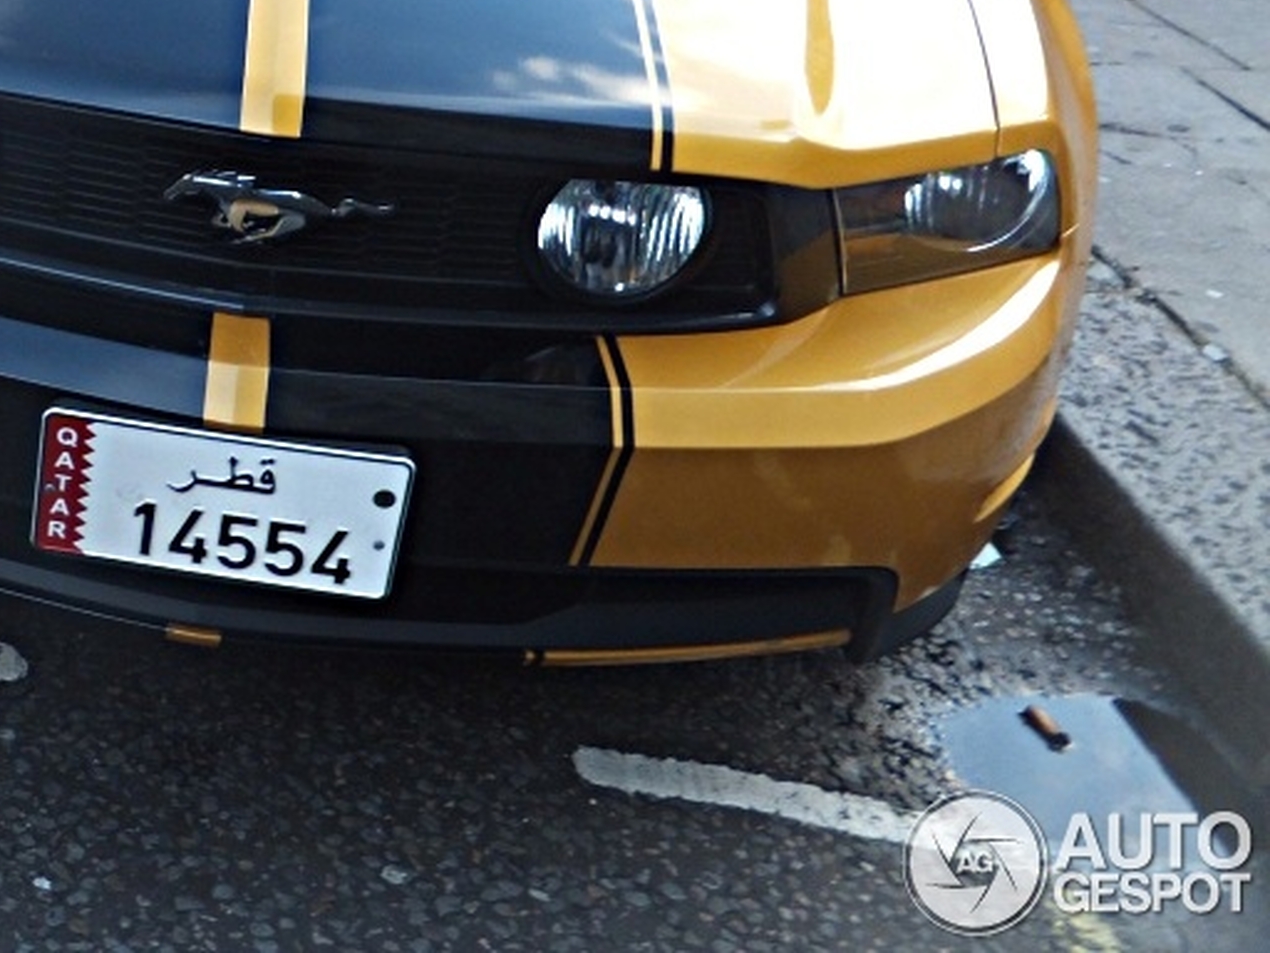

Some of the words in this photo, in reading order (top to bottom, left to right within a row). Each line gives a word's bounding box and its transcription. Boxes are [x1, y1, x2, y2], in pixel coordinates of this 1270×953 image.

[47, 426, 79, 540] QATAR
[167, 456, 277, 495] قطر
[133, 502, 352, 585] 14554
